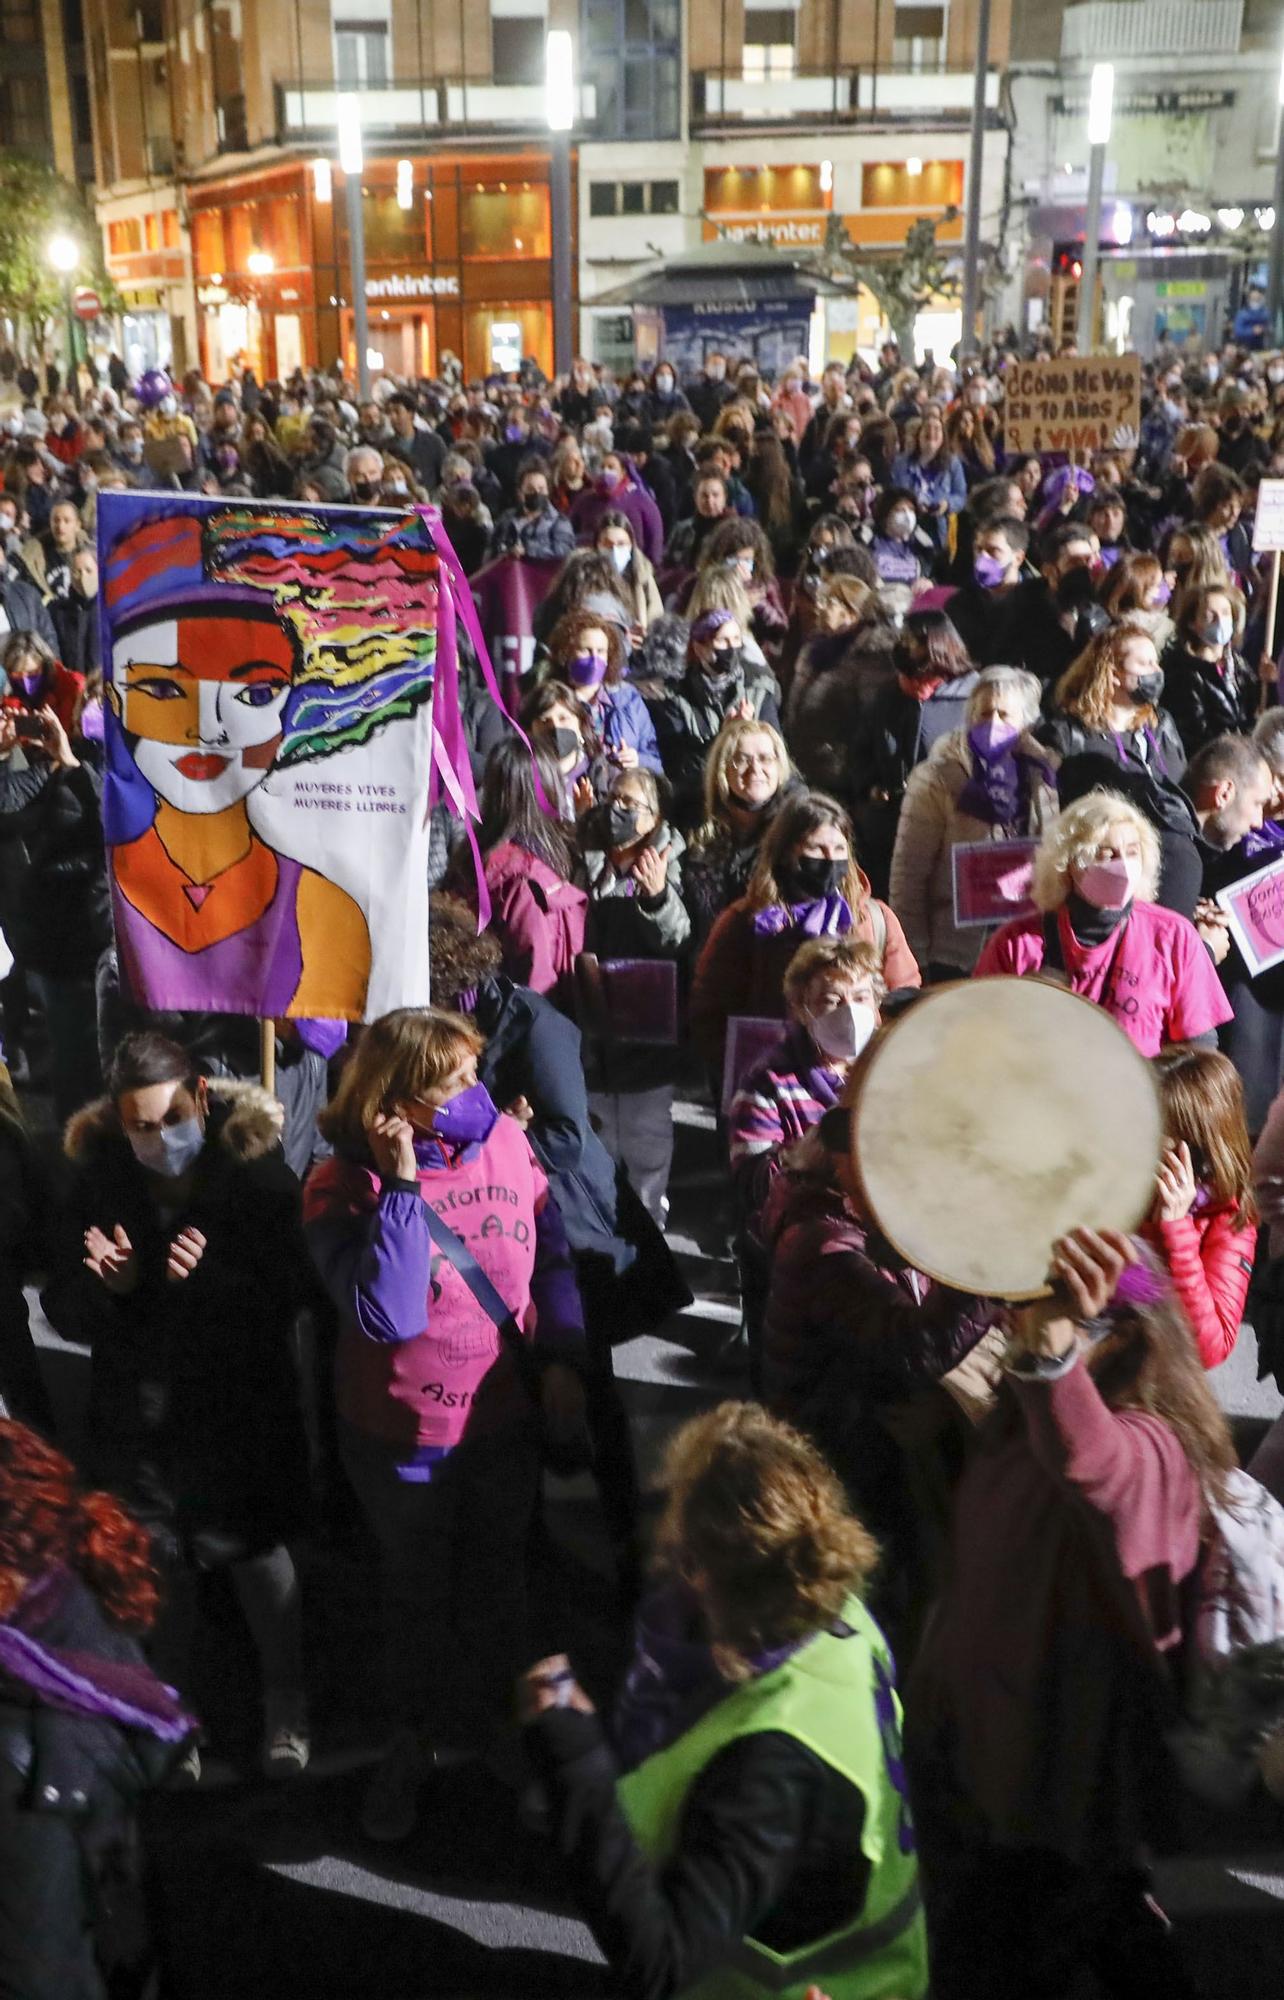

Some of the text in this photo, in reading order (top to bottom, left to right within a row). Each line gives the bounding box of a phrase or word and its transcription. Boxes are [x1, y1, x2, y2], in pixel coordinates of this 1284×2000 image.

[294, 782, 396, 797] MUYERES VIVES
[294, 799, 407, 814] MUYERES LLIBRES
[431, 1183, 519, 1214] aforma
